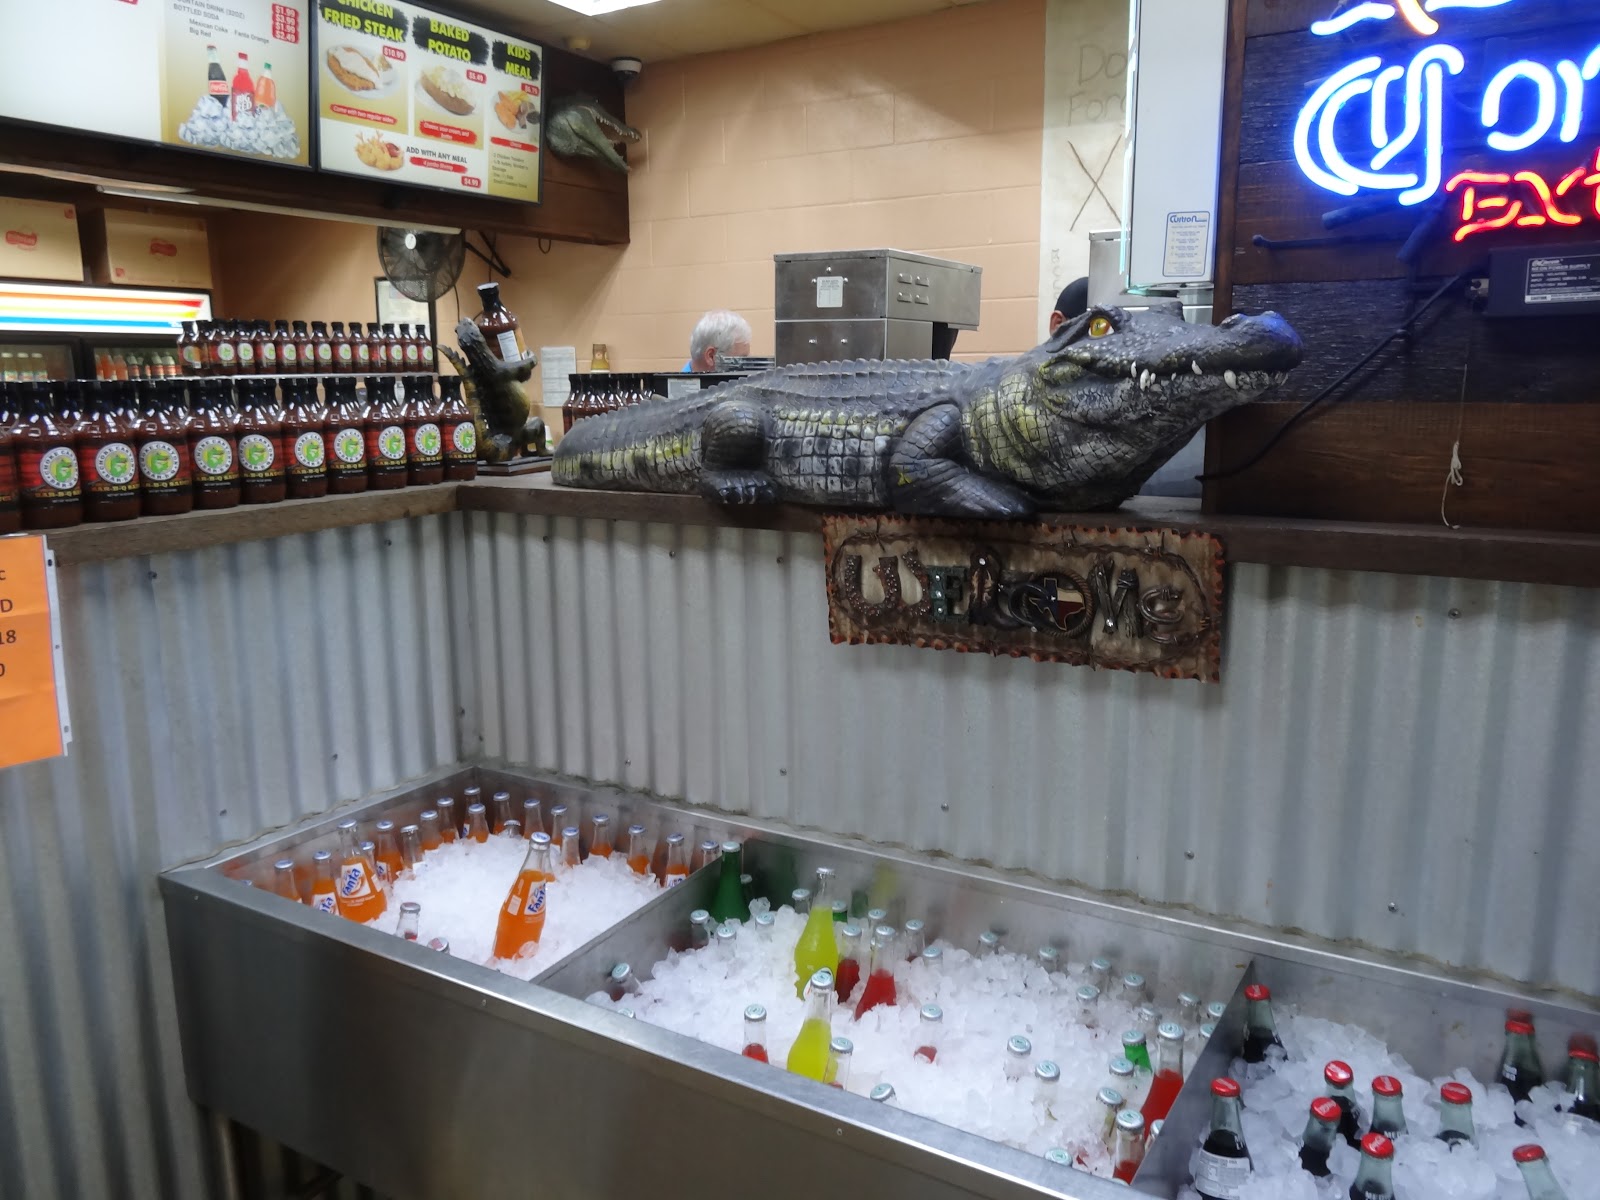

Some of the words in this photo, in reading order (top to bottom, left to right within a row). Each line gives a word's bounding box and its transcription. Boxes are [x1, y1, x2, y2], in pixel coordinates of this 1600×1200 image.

[173, 3, 202, 16] BOTTLED
[203, 11, 219, 20] SODA
[206, 3, 224, 13] DRINK
[275, 5, 296, 17] $1.99
[189, 18, 213, 29] Mexican
[214, 25, 229, 33] Coke
[234, 29, 250, 39] Fanta
[251, 34, 270, 44] Orange
[189, 27, 199, 36] Big
[200, 29, 212, 38] Red
[275, 22, 296, 34] $1.99
[324, 7, 361, 30] FRIED
[364, 19, 405, 42] STEAK
[430, 17, 470, 42] BAKED
[428, 38, 471, 62] POTATO
[507, 43, 531, 61] KIDS
[505, 61, 532, 80] MEAL
[406, 146, 420, 155] ADD
[421, 149, 437, 158] WITH
[438, 152, 451, 161] ANY
[452, 155, 468, 164] MEAL
[464, 177, 479, 187] $4.99
[342, 868, 361, 896] Fanta
